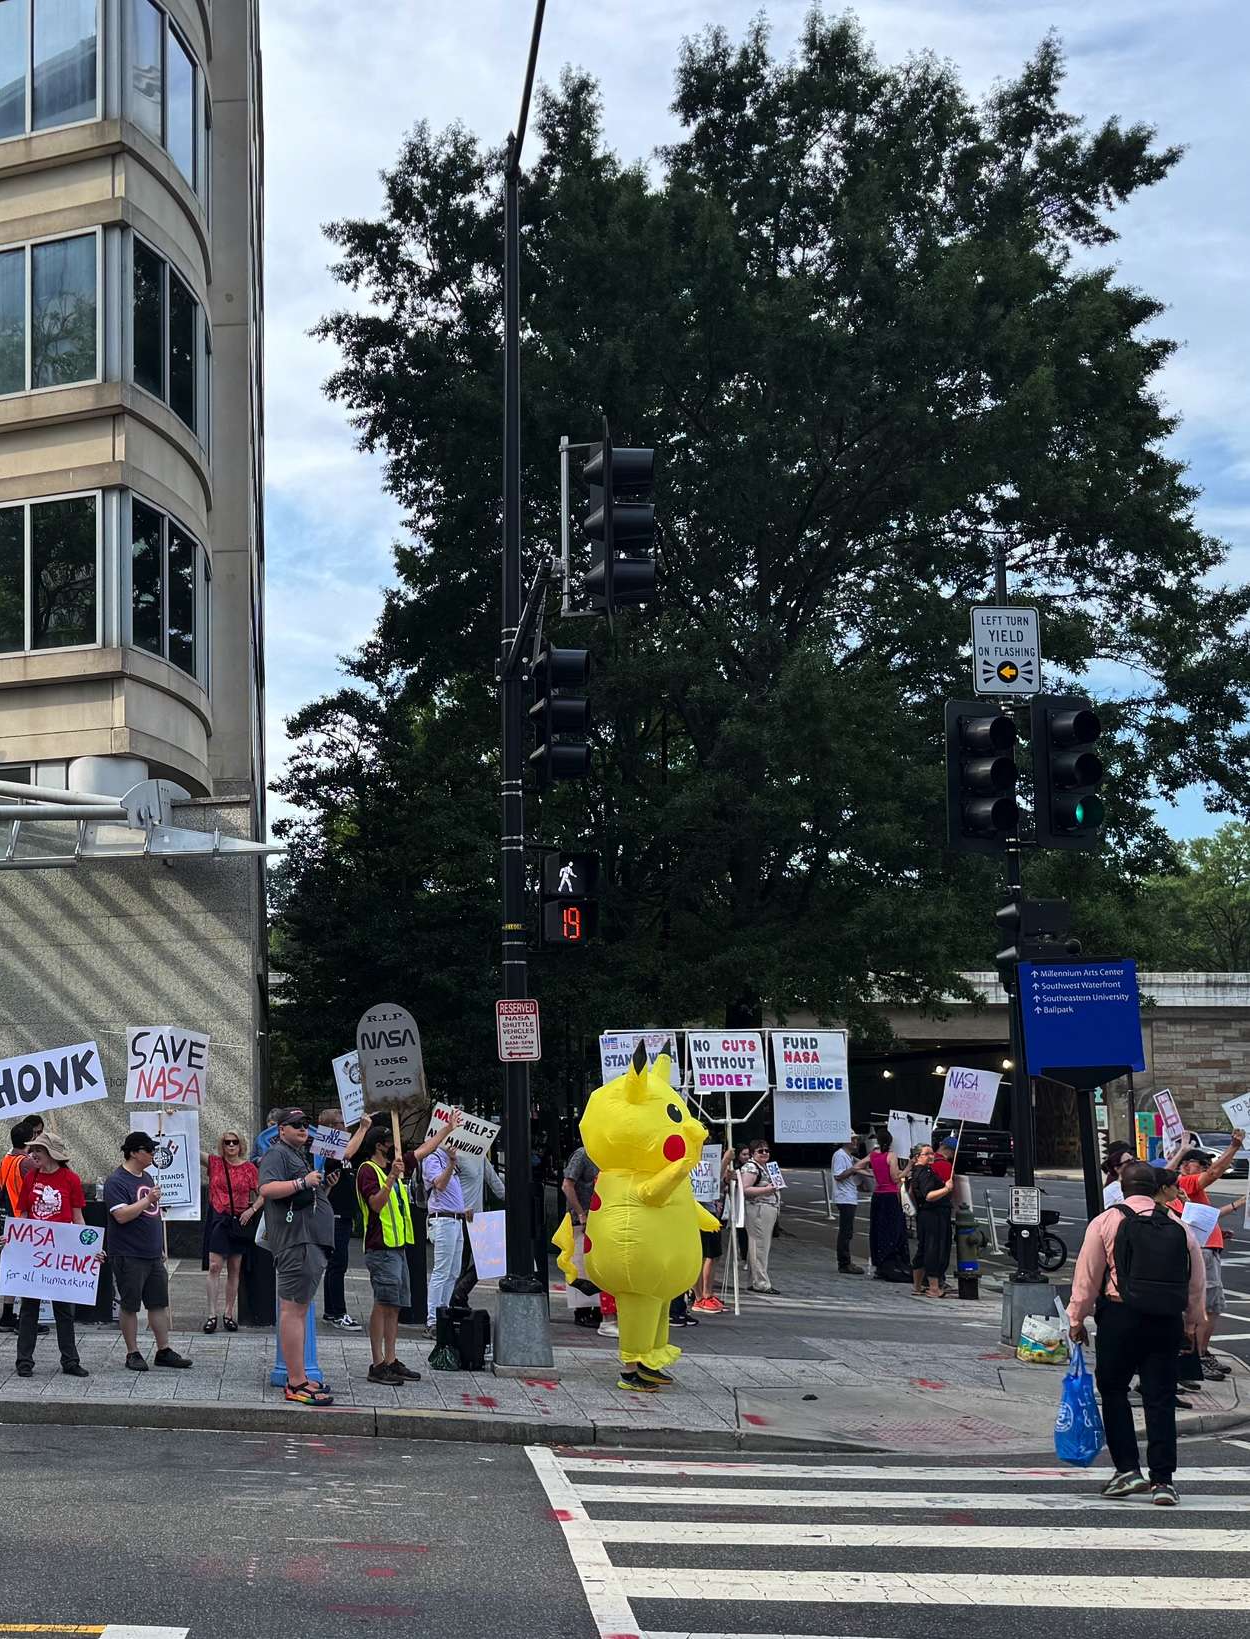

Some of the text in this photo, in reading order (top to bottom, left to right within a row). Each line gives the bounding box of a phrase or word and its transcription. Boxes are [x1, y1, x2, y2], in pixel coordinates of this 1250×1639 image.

[981, 616, 1029, 626] LEFT TURN
[989, 630, 1024, 642] YIELD
[978, 647, 1035, 657] ON FLASHING
[563, 907, 581, 939] 19
[1042, 993, 1129, 1002] Southeastern University
[500, 1003, 535, 1013] RESERVED
[1043, 1006, 1074, 1015] Ballpark
[366, 1013, 406, 1022] R.I.P.
[360, 1029, 416, 1050] NASA
[693, 1040, 756, 1051] NO CUTS
[783, 1037, 818, 1049] FUND
[130, 1032, 206, 1070] SAVE
[784, 1051, 820, 1063] NASA
[374, 1056, 408, 1066] 1958
[604, 1053, 633, 1068] STAN
[696, 1057, 755, 1069] WITHOUT
[136, 1066, 201, 1105] NASA
[375, 1078, 412, 1088] 2025
[699, 1074, 752, 1086] BUDGET
[786, 1077, 843, 1090] SCIENCE
[949, 1071, 978, 1091] NASA
[1230, 1103, 1243, 1113] TO
[463, 1120, 496, 1139] HELPS
[445, 1136, 483, 1156] MANKIND
[161, 1173, 184, 1181] STANDS
[7, 1223, 55, 1248] NASA
[6, 1269, 20, 1284] for
[22, 1271, 34, 1282] all
